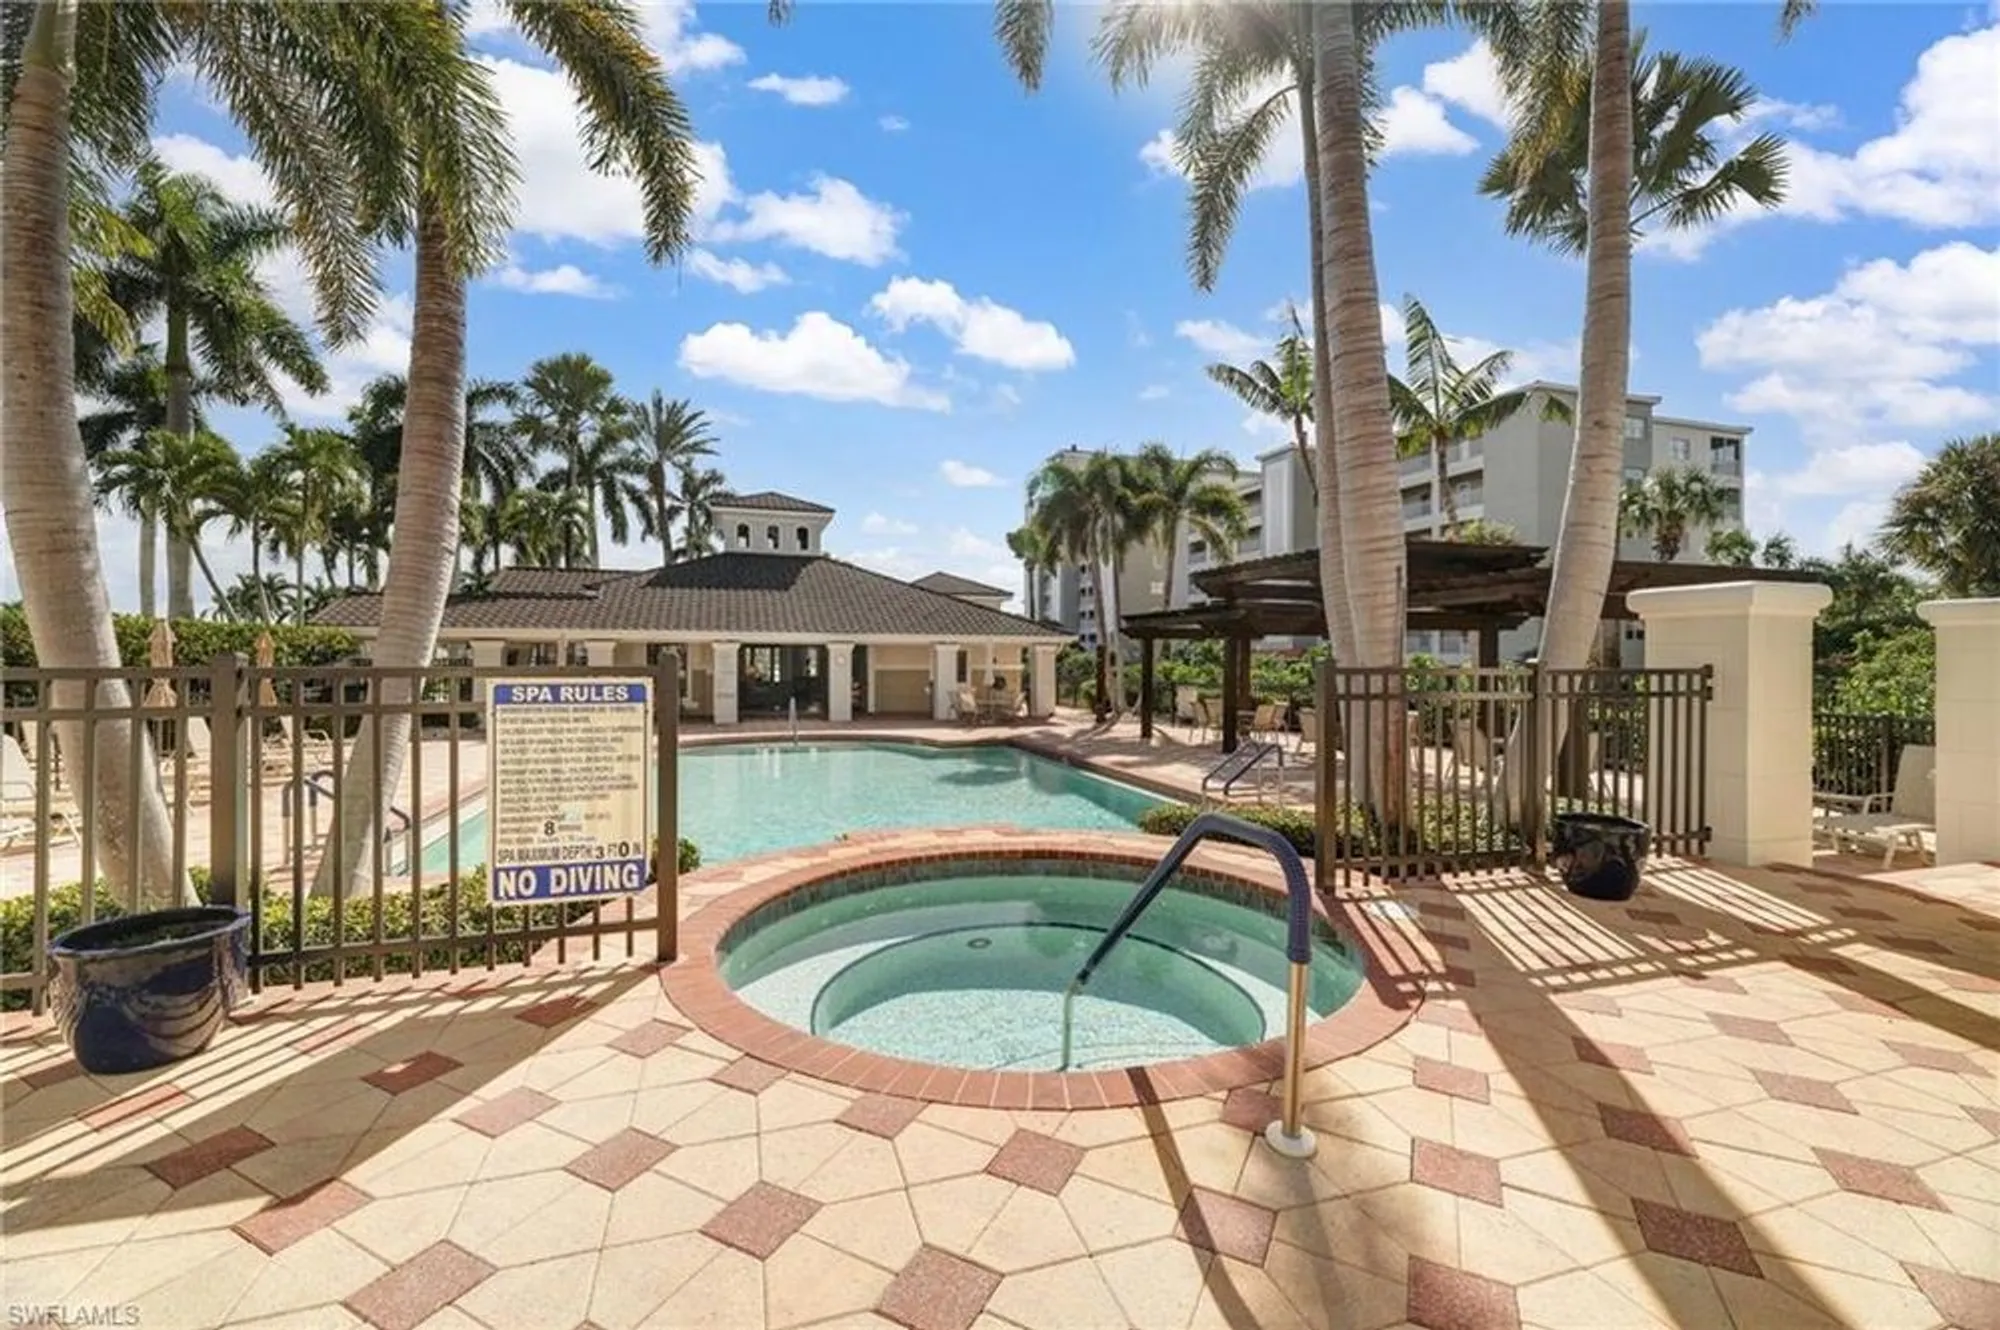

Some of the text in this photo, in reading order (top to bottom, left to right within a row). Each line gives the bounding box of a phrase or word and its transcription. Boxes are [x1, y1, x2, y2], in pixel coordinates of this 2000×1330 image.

[512, 685, 629, 702] SPA RULES
[543, 820, 556, 836] 8
[498, 848, 515, 864] SPA
[595, 845, 605, 859] 3
[618, 841, 630, 858] 0
[498, 862, 640, 898] NO DIVING
